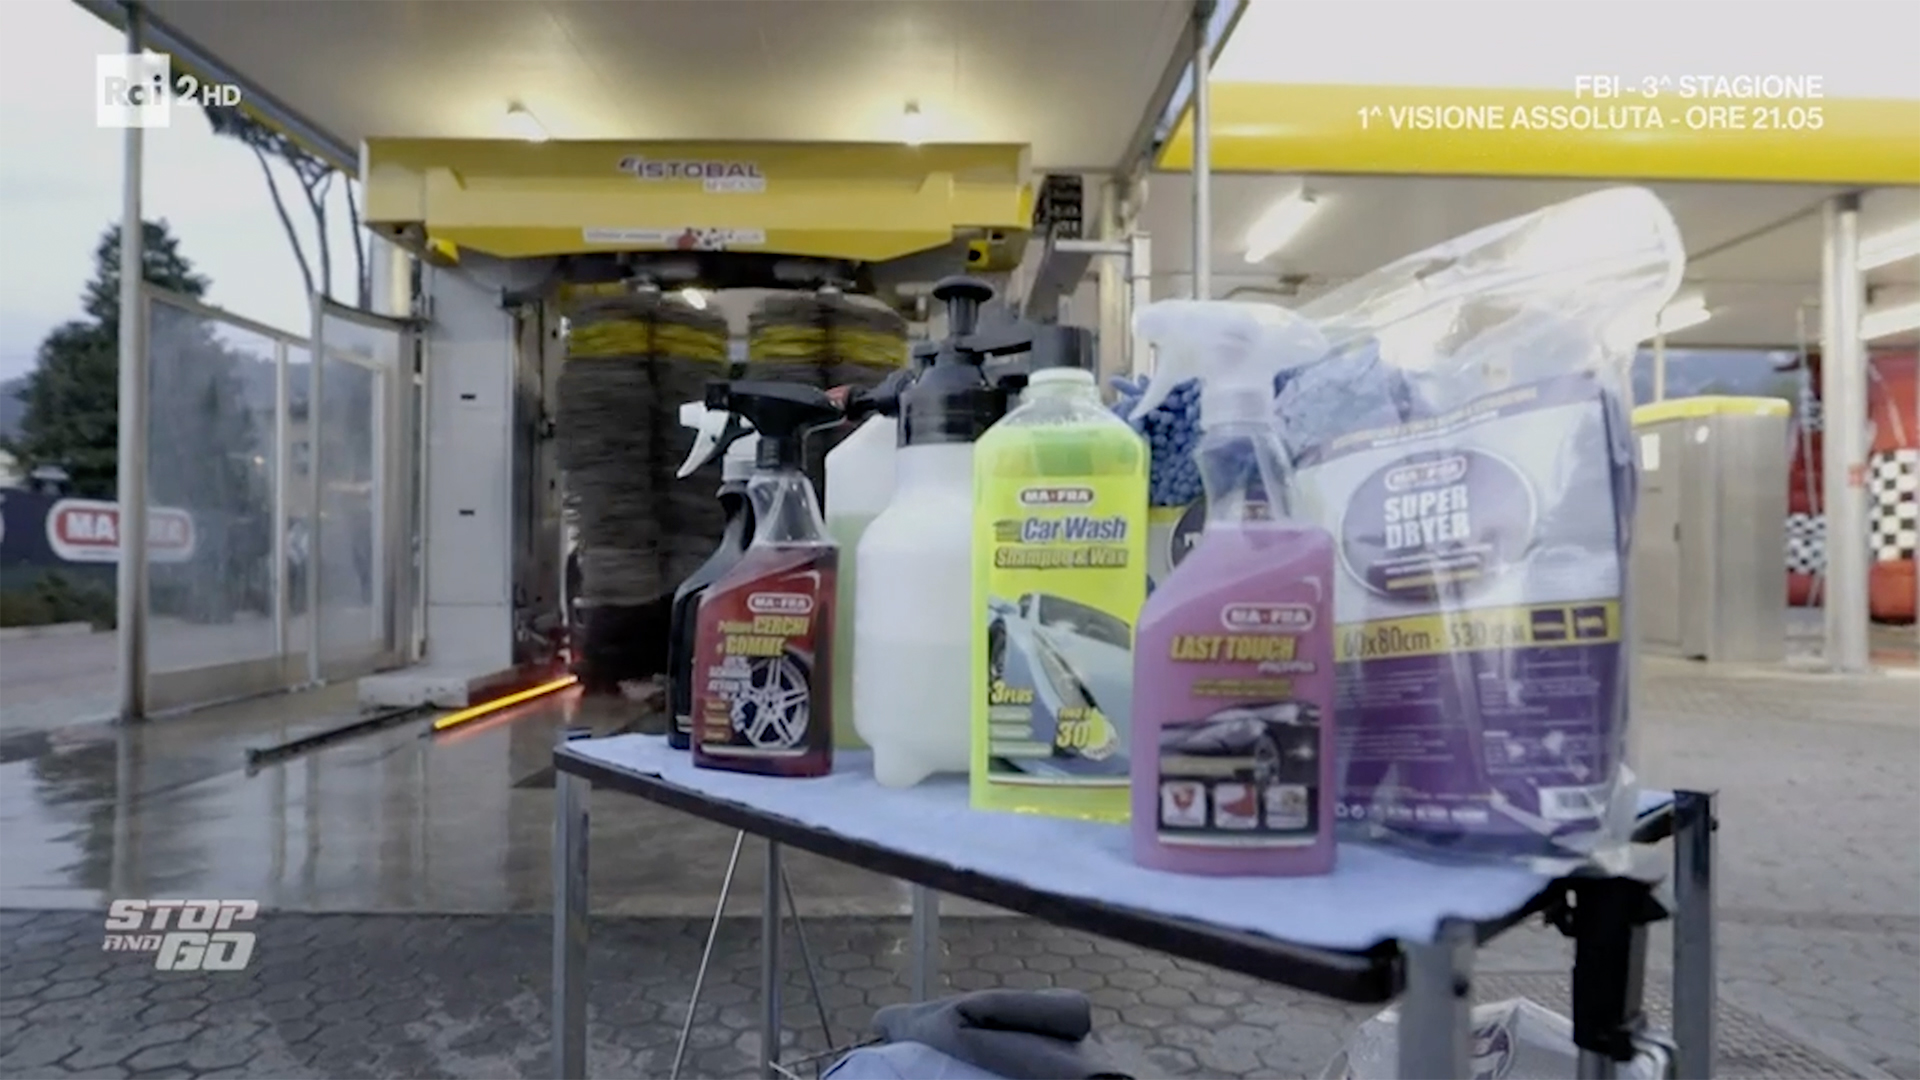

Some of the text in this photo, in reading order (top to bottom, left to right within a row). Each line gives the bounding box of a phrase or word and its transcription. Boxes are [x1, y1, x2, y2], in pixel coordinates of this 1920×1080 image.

[637, 161, 762, 179] ISTOBAL
[1384, 484, 1468, 522] SUPER
[1024, 517, 1060, 540] Car
[1064, 516, 1127, 540] Wash
[1385, 511, 1470, 549] DRYER
[996, 546, 1074, 570] Shampoo
[753, 615, 810, 636] CERCHI
[1171, 635, 1296, 661] LAST TOUCH
